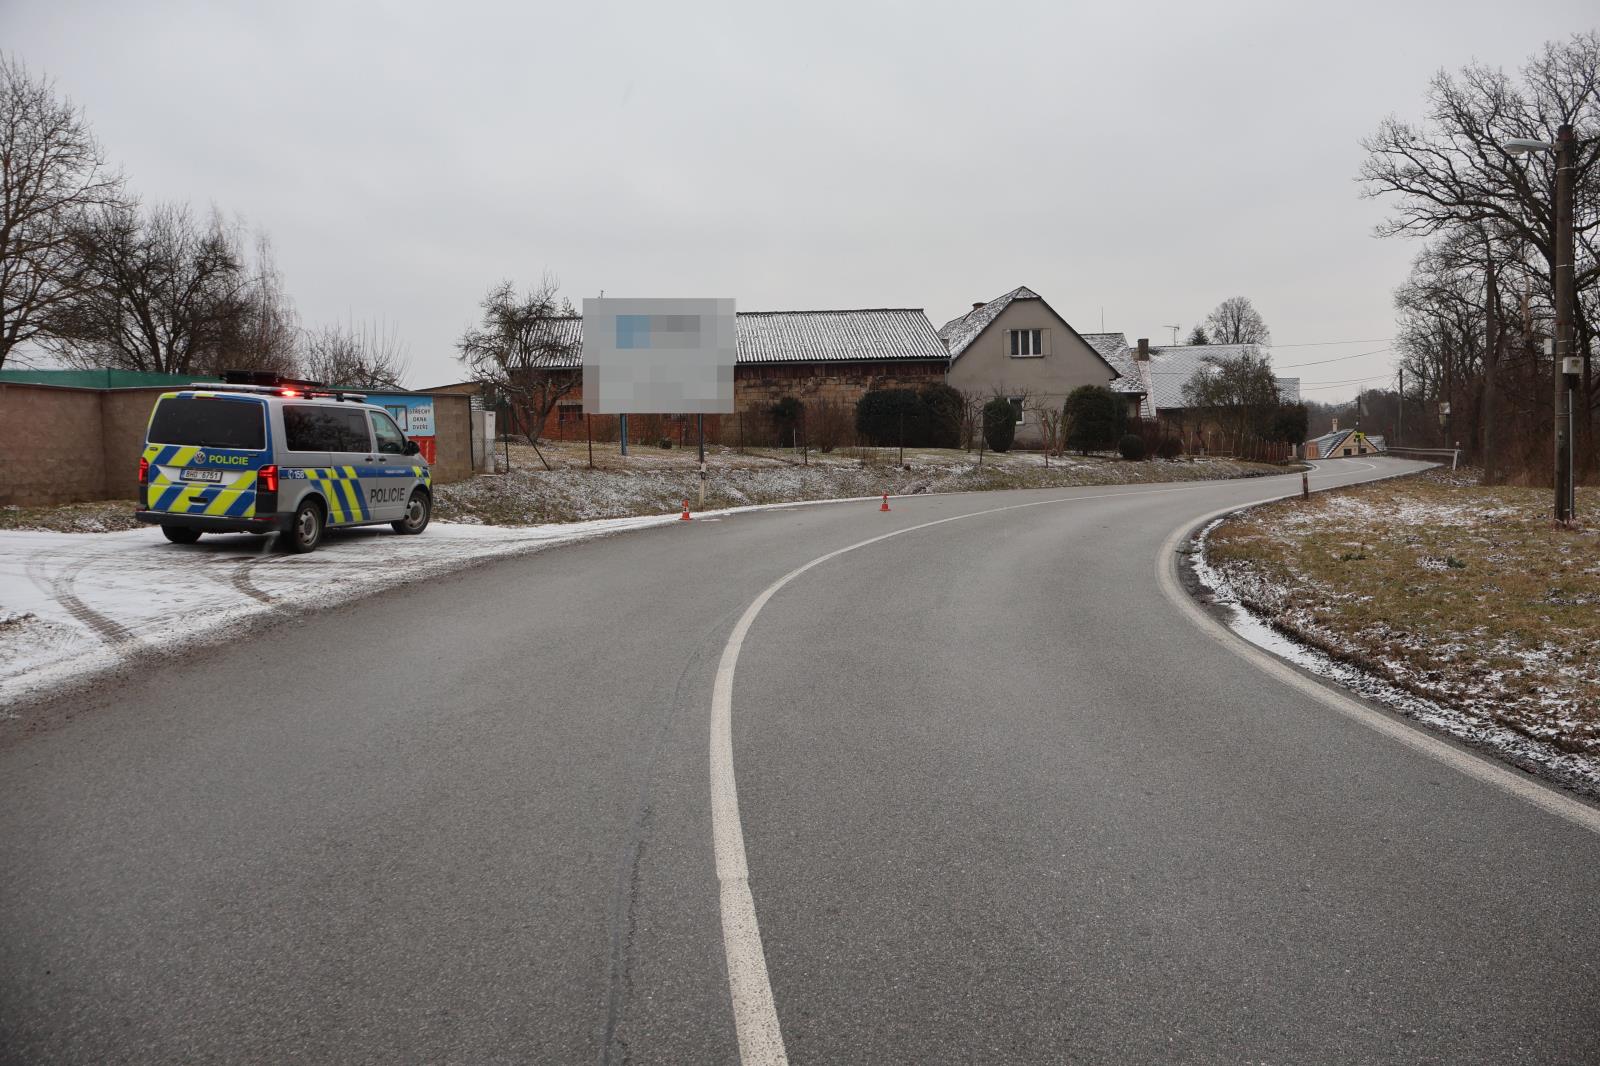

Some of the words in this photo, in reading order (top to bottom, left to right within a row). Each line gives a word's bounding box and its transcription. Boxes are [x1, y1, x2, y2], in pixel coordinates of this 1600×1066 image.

[209, 455, 248, 465] POLICIE
[294, 470, 304, 479] 158
[370, 487, 405, 503] POLICIE
